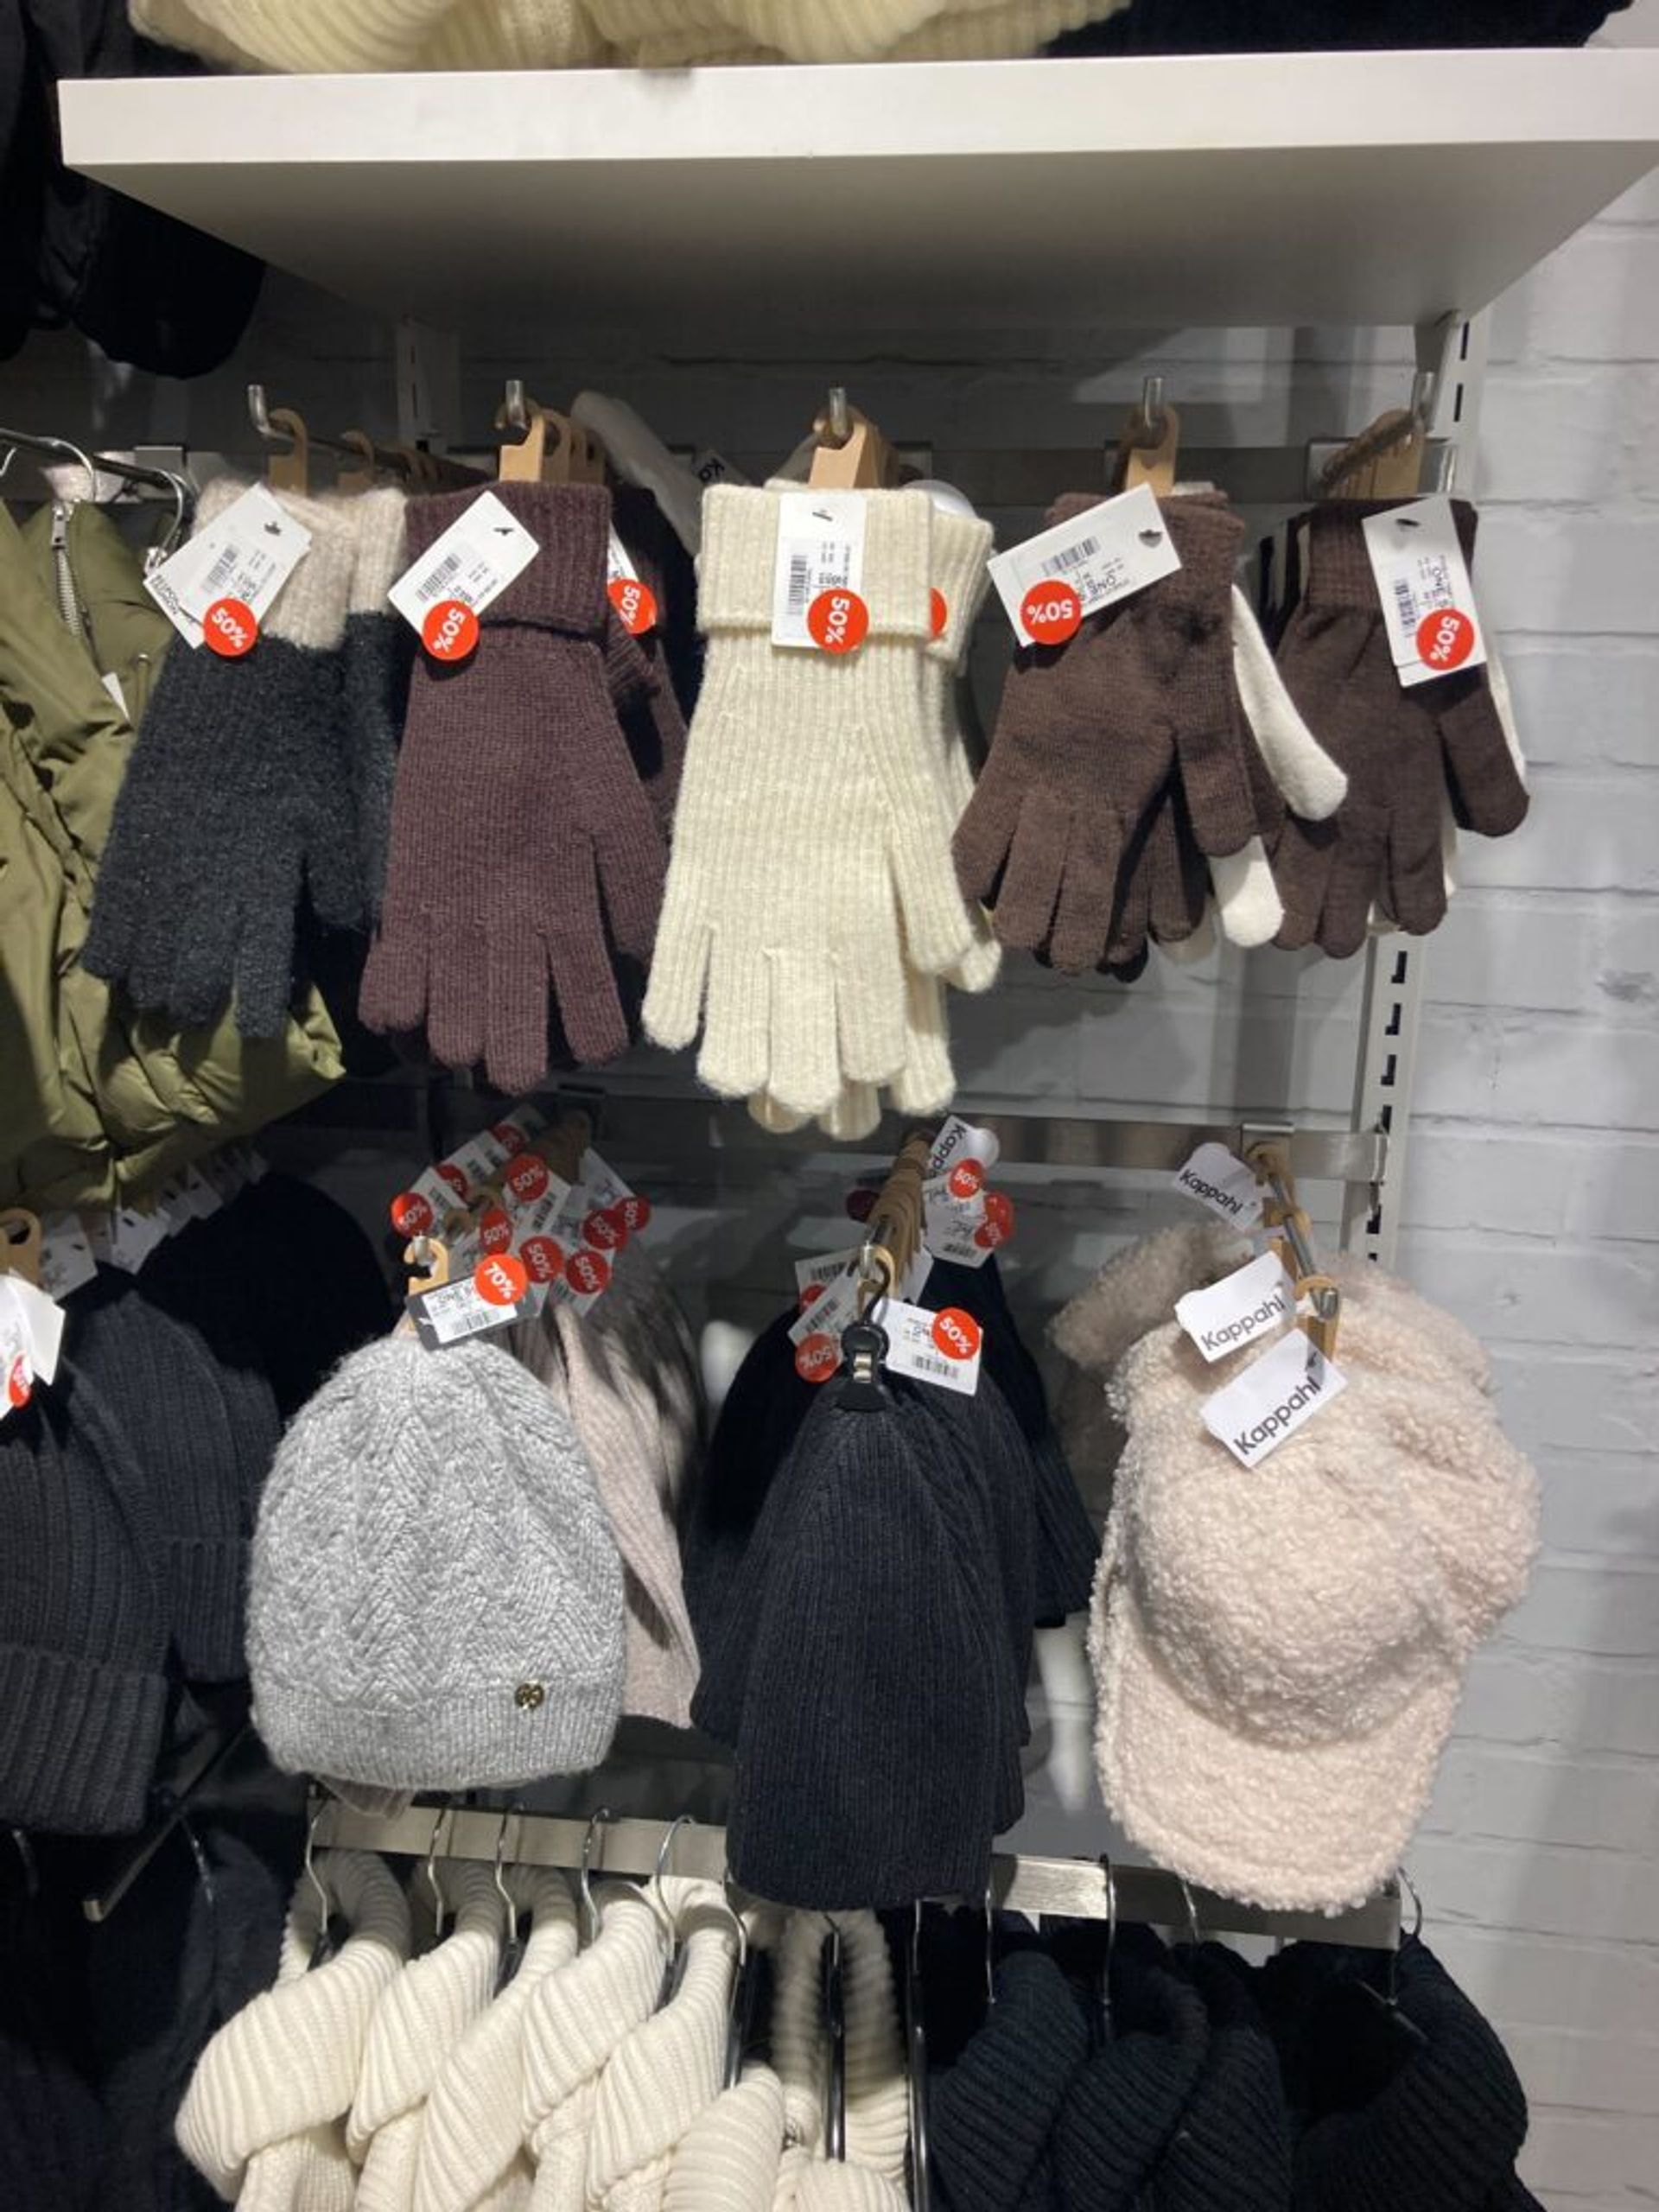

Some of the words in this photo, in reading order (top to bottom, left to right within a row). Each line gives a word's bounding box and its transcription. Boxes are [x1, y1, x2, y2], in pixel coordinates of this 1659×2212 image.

[619, 585, 640, 626] 50%
[824, 596, 850, 645] 50%
[1026, 599, 1073, 625] 50%
[211, 607, 248, 649] 50%
[433, 607, 466, 653] 50%
[1430, 616, 1461, 662] 50%
[512, 1164, 543, 1192] 50%
[1179, 1168, 1244, 1215] Kappahl
[398, 1201, 428, 1230] 50%
[483, 1221, 509, 1246] 50%
[528, 1243, 553, 1279] 50%
[575, 1255, 601, 1290] 50%
[484, 1262, 518, 1300] 70%
[939, 1316, 972, 1355] 50%
[1200, 1294, 1287, 1351] Kappahl
[798, 1345, 831, 1371] 50%
[1233, 1375, 1322, 1455] Kappahl
